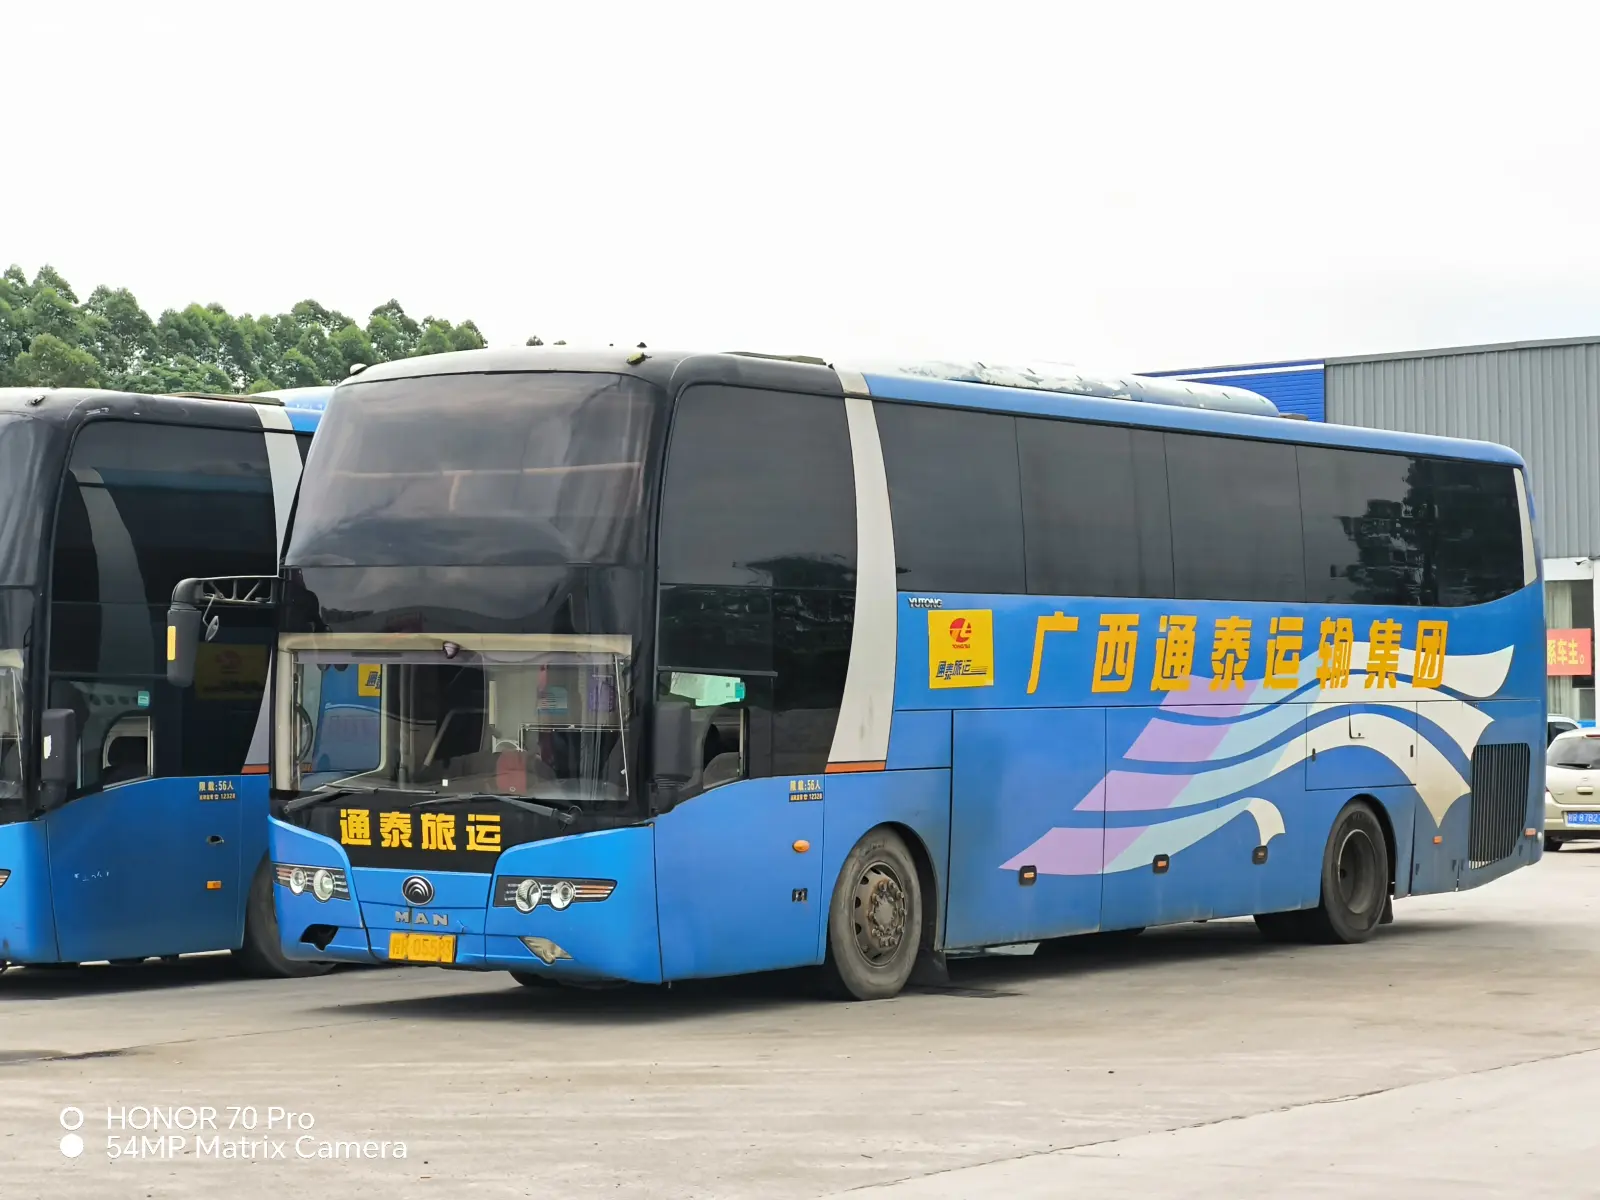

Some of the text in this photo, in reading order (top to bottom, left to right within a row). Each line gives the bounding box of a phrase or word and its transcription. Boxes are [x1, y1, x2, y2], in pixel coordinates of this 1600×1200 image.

[908, 597, 943, 608] YUTONG
[1026, 611, 1449, 694] 广西通泰运输集团
[340, 808, 501, 852] 通泰旅运
[395, 911, 448, 926] MAN
